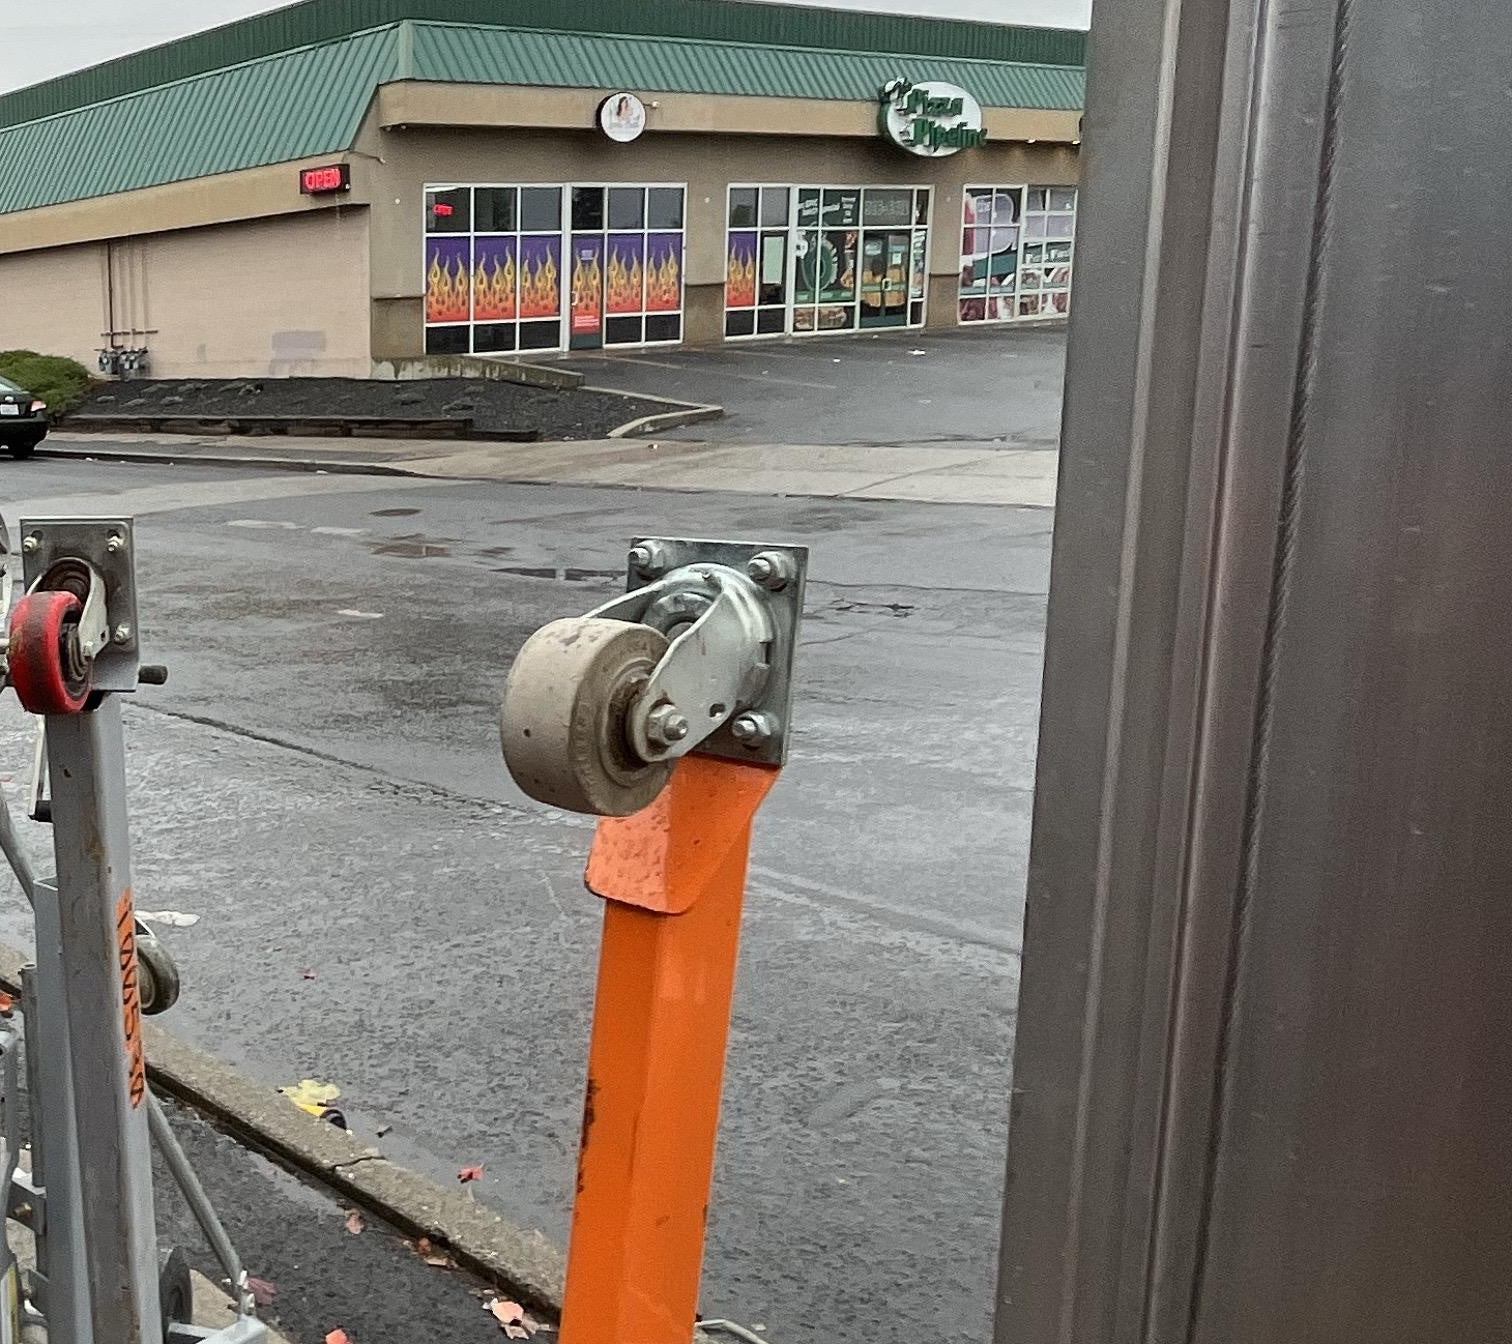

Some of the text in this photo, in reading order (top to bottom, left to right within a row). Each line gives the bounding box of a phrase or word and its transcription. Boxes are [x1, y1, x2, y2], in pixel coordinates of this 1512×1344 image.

[902, 89, 963, 117] Pizza
[904, 119, 987, 153] Pipeline
[305, 167, 341, 191] OPEN
